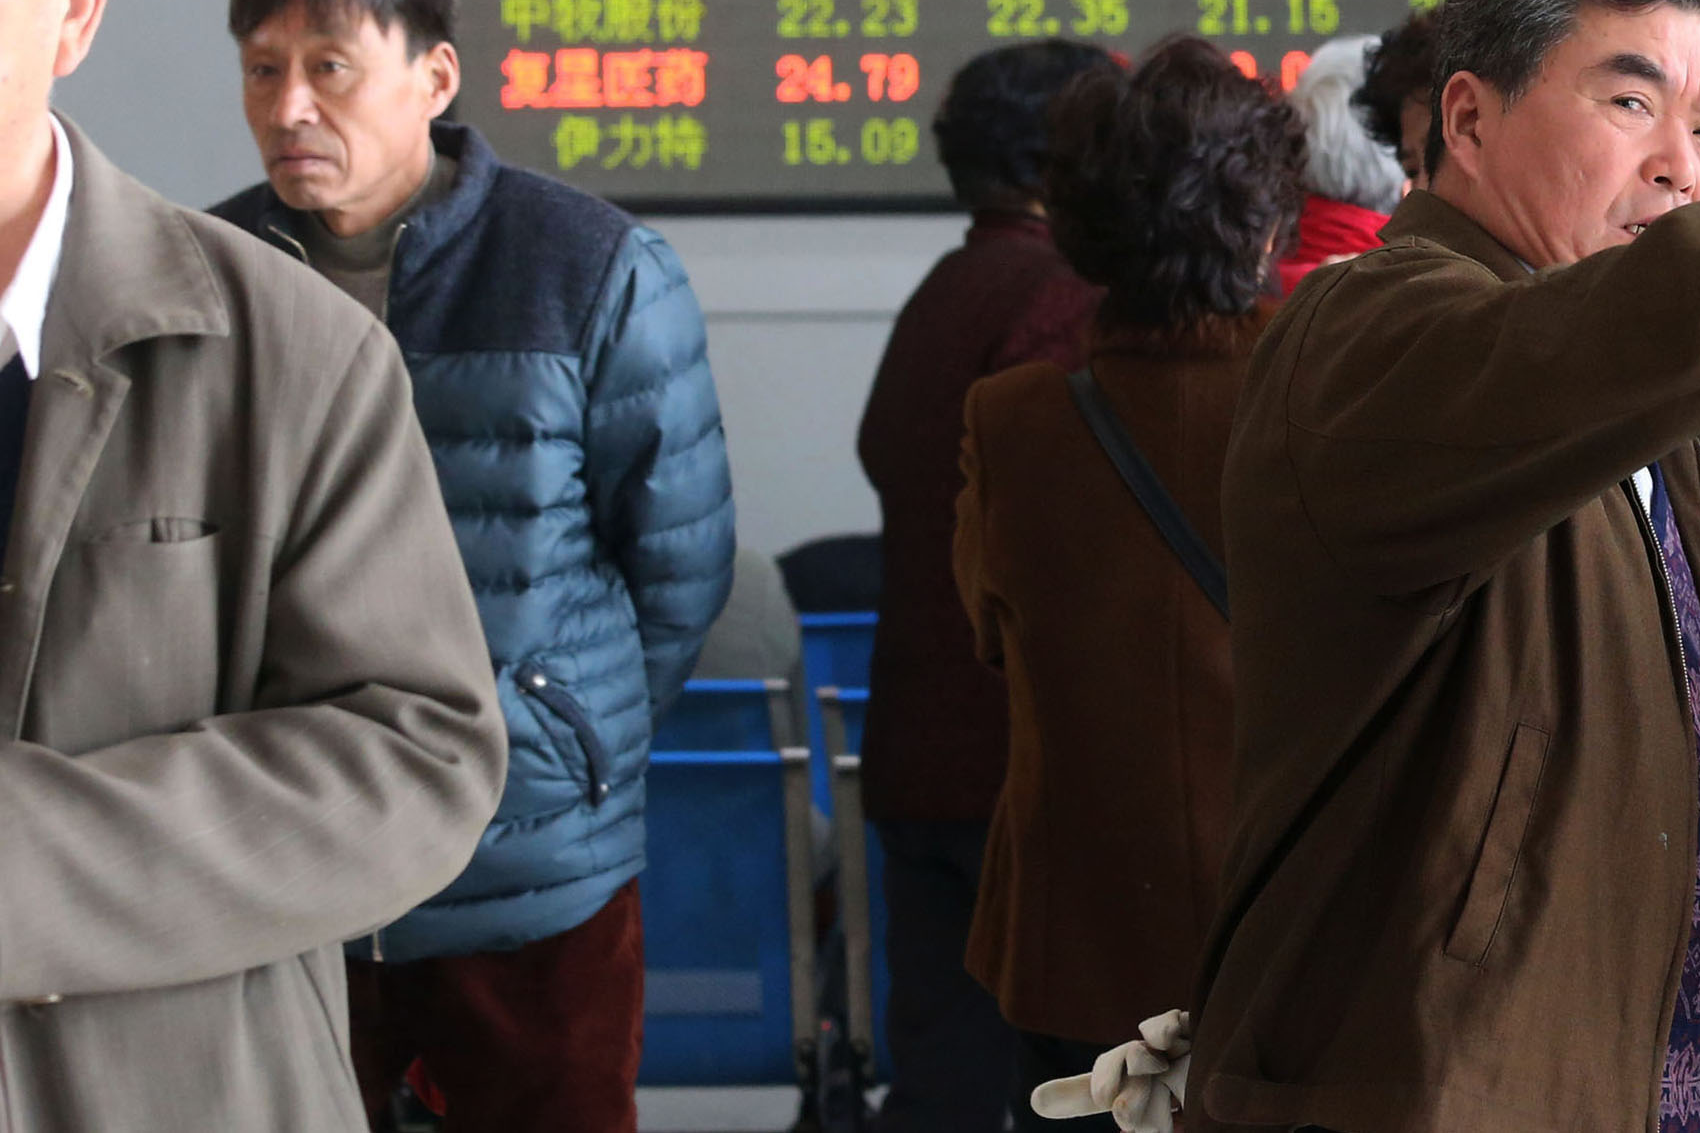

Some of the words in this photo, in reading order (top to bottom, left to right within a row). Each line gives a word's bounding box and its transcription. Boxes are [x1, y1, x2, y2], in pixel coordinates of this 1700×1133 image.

[775, 53, 920, 103] 24.79
[553, 116, 705, 168] 伊力特
[784, 119, 918, 164] 15.09
